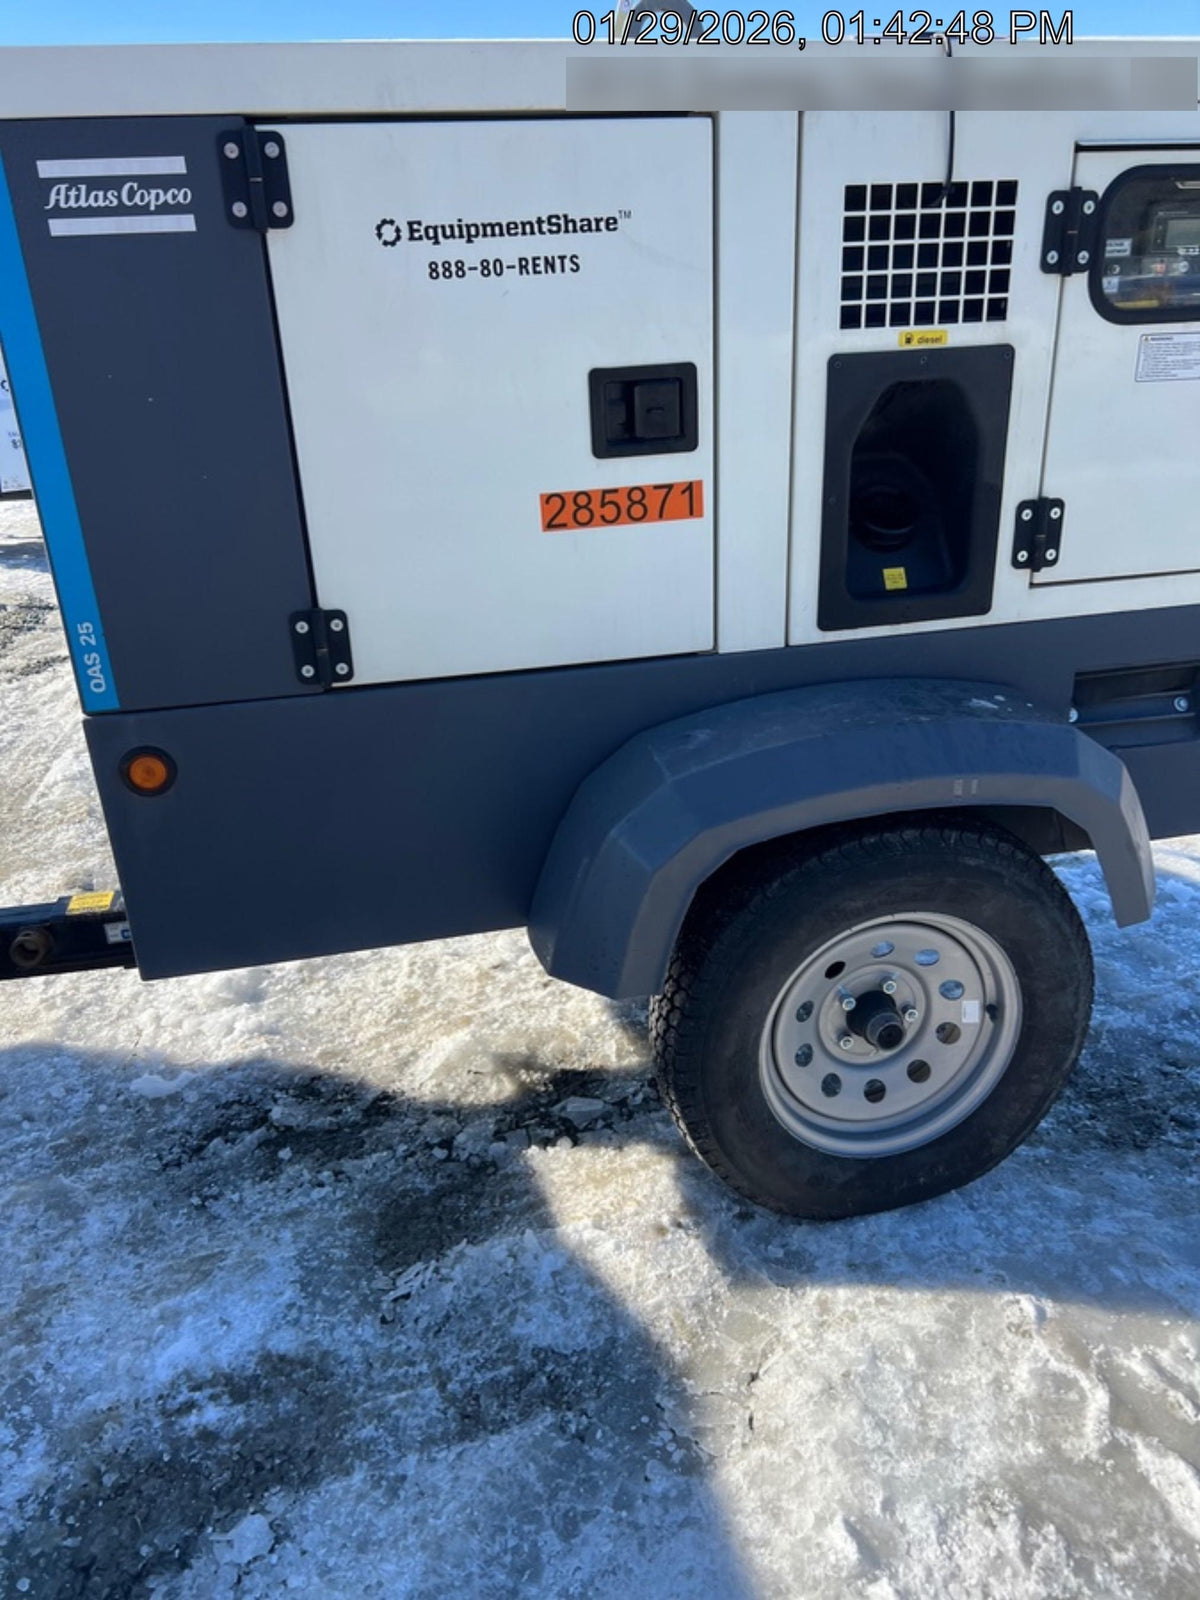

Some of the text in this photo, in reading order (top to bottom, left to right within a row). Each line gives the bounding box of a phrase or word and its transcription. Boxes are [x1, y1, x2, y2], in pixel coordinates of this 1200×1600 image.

[44, 181, 192, 211] Atlas Copco
[406, 213, 619, 246] EquipmentShare
[428, 254, 581, 280] 888-80-RENTS
[545, 481, 694, 529] 285871
[77, 621, 97, 646] 25
